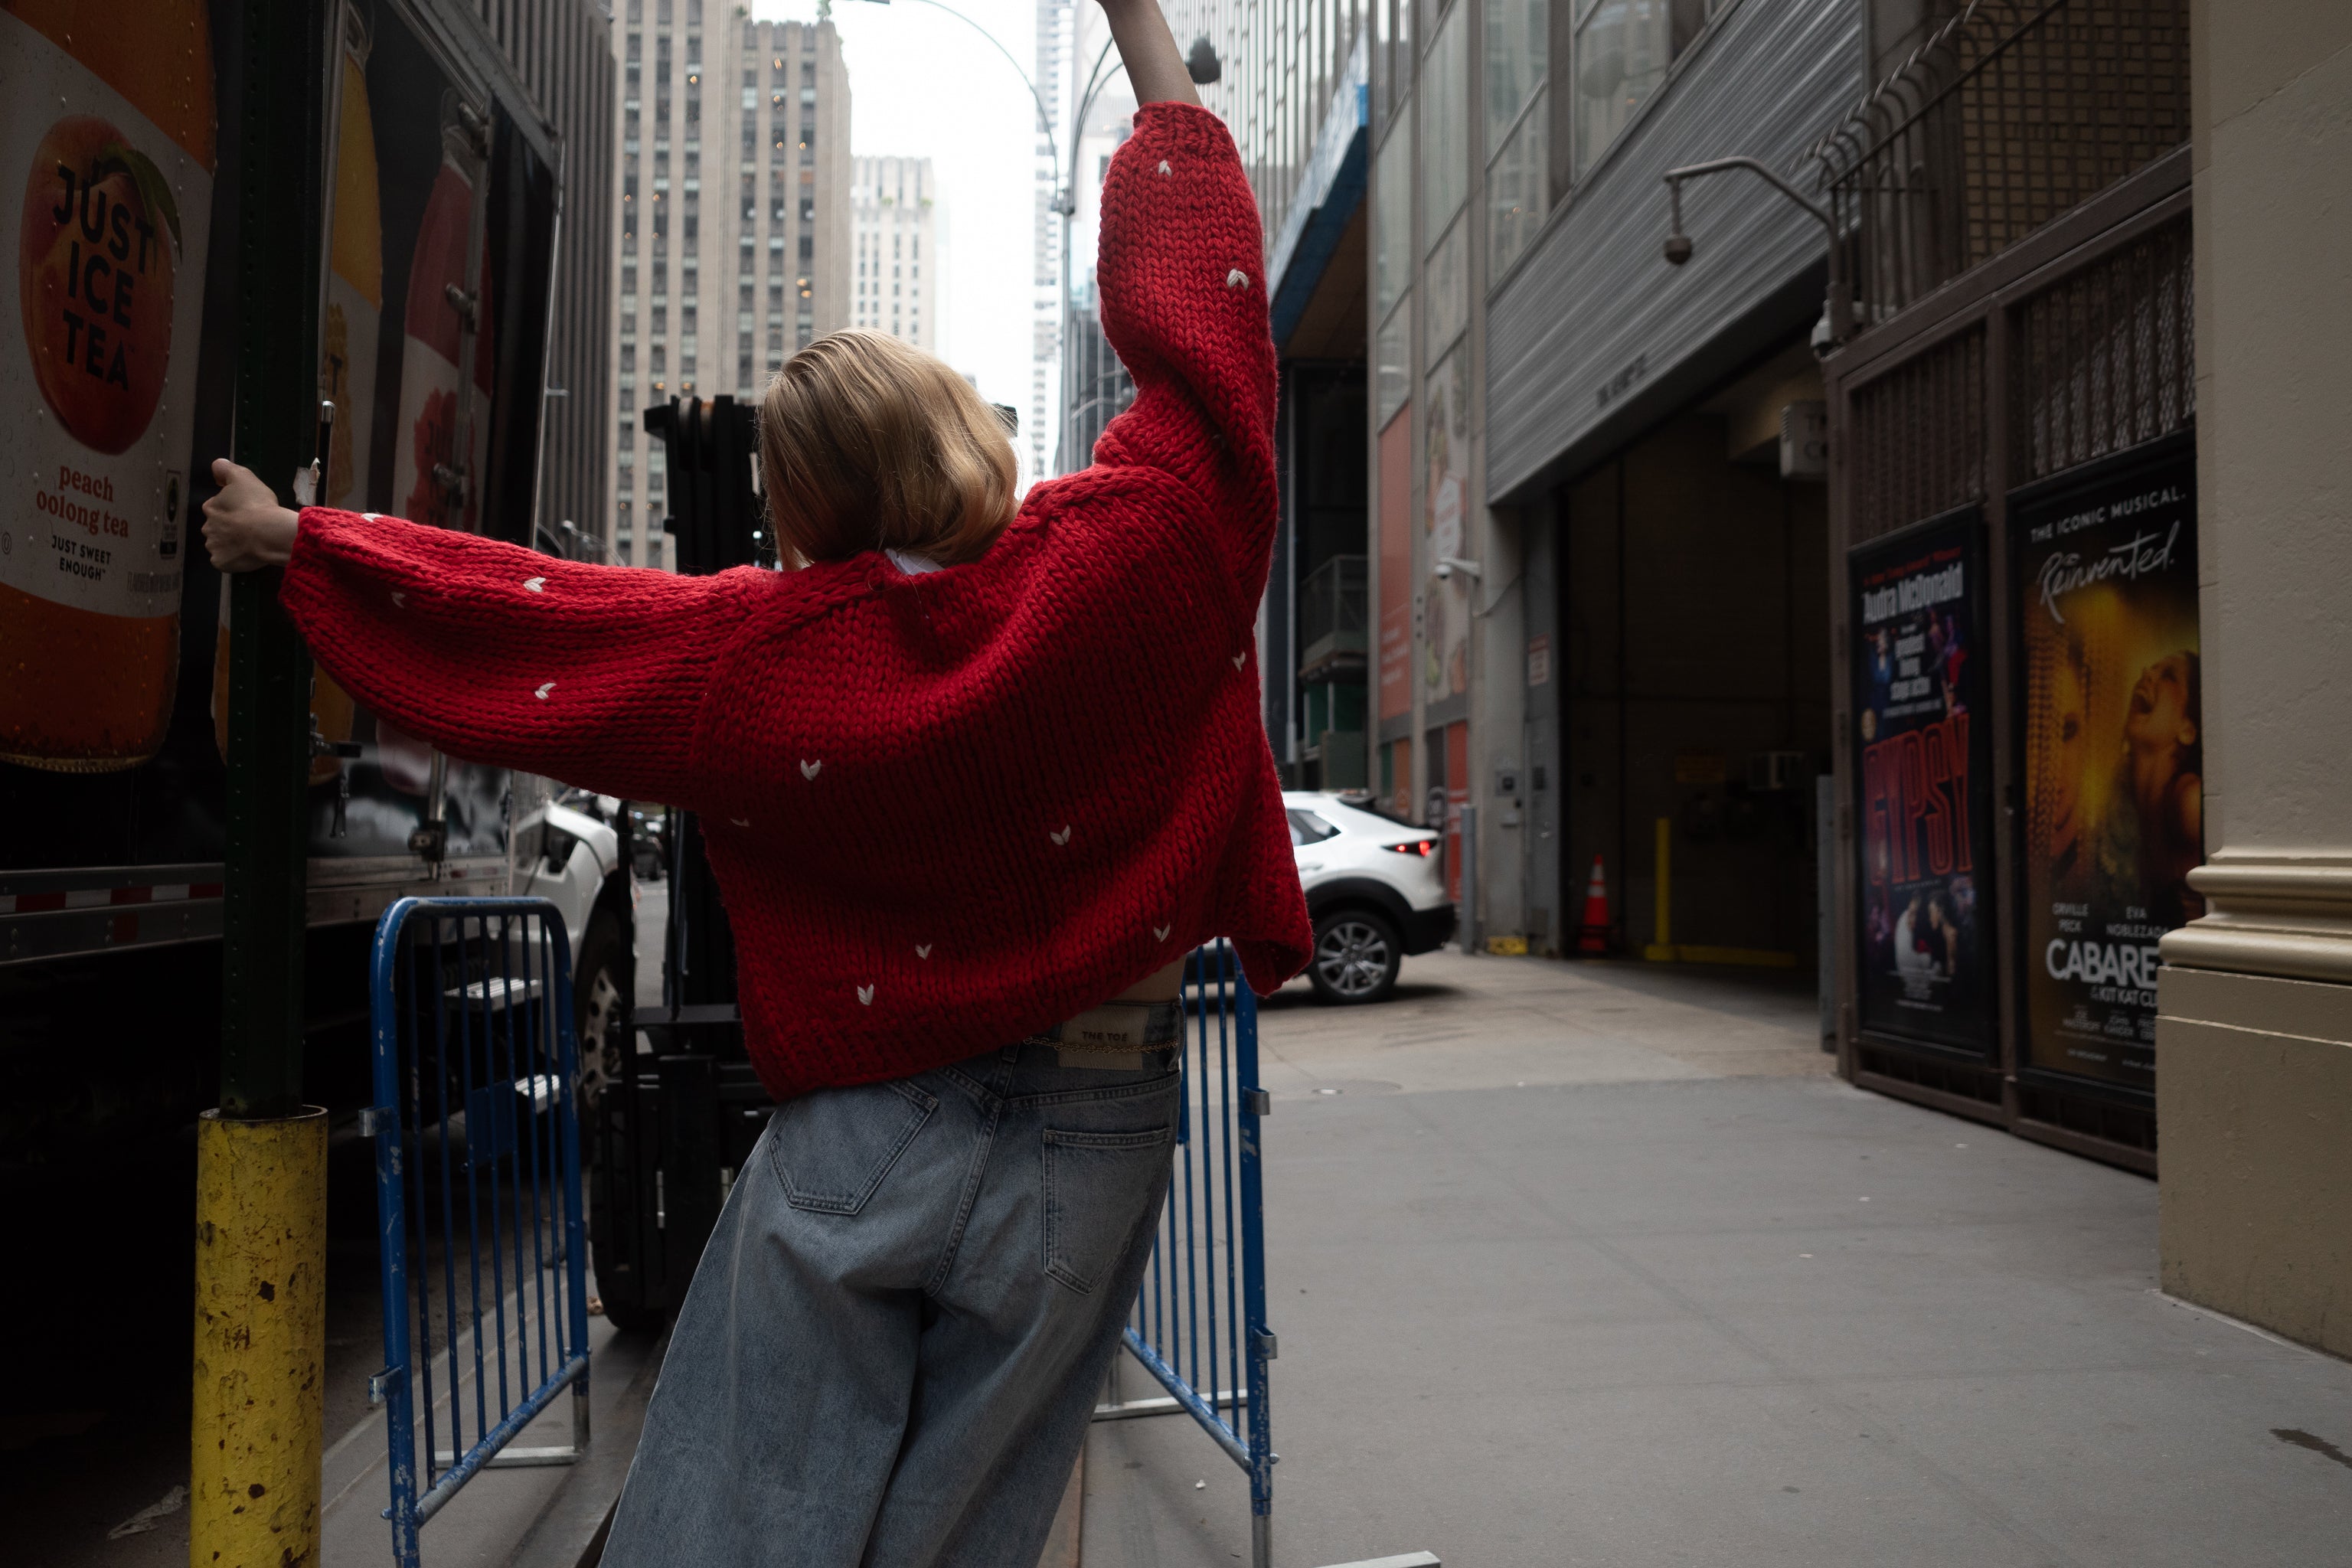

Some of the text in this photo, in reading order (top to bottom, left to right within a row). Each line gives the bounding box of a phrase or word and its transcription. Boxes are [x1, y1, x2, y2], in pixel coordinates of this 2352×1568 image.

[54, 164, 154, 275] JUST
[69, 240, 134, 329] ICE
[59, 465, 114, 502] peach
[36, 490, 100, 536] oolong
[103, 509, 129, 537] tea
[2030, 485, 2187, 544] THE ICONIC MUSICAL.
[51, 535, 112, 564] JUST SWEET
[1898, 560, 1964, 613] McDonald
[1862, 713, 1974, 887] GYPSY
[2052, 901, 2089, 917] ORVILLE
[2058, 918, 2082, 933] PECK
[2125, 905, 2148, 920] EVA
[2045, 937, 2158, 991] CABARE
[1082, 1031, 1103, 1040] THE
